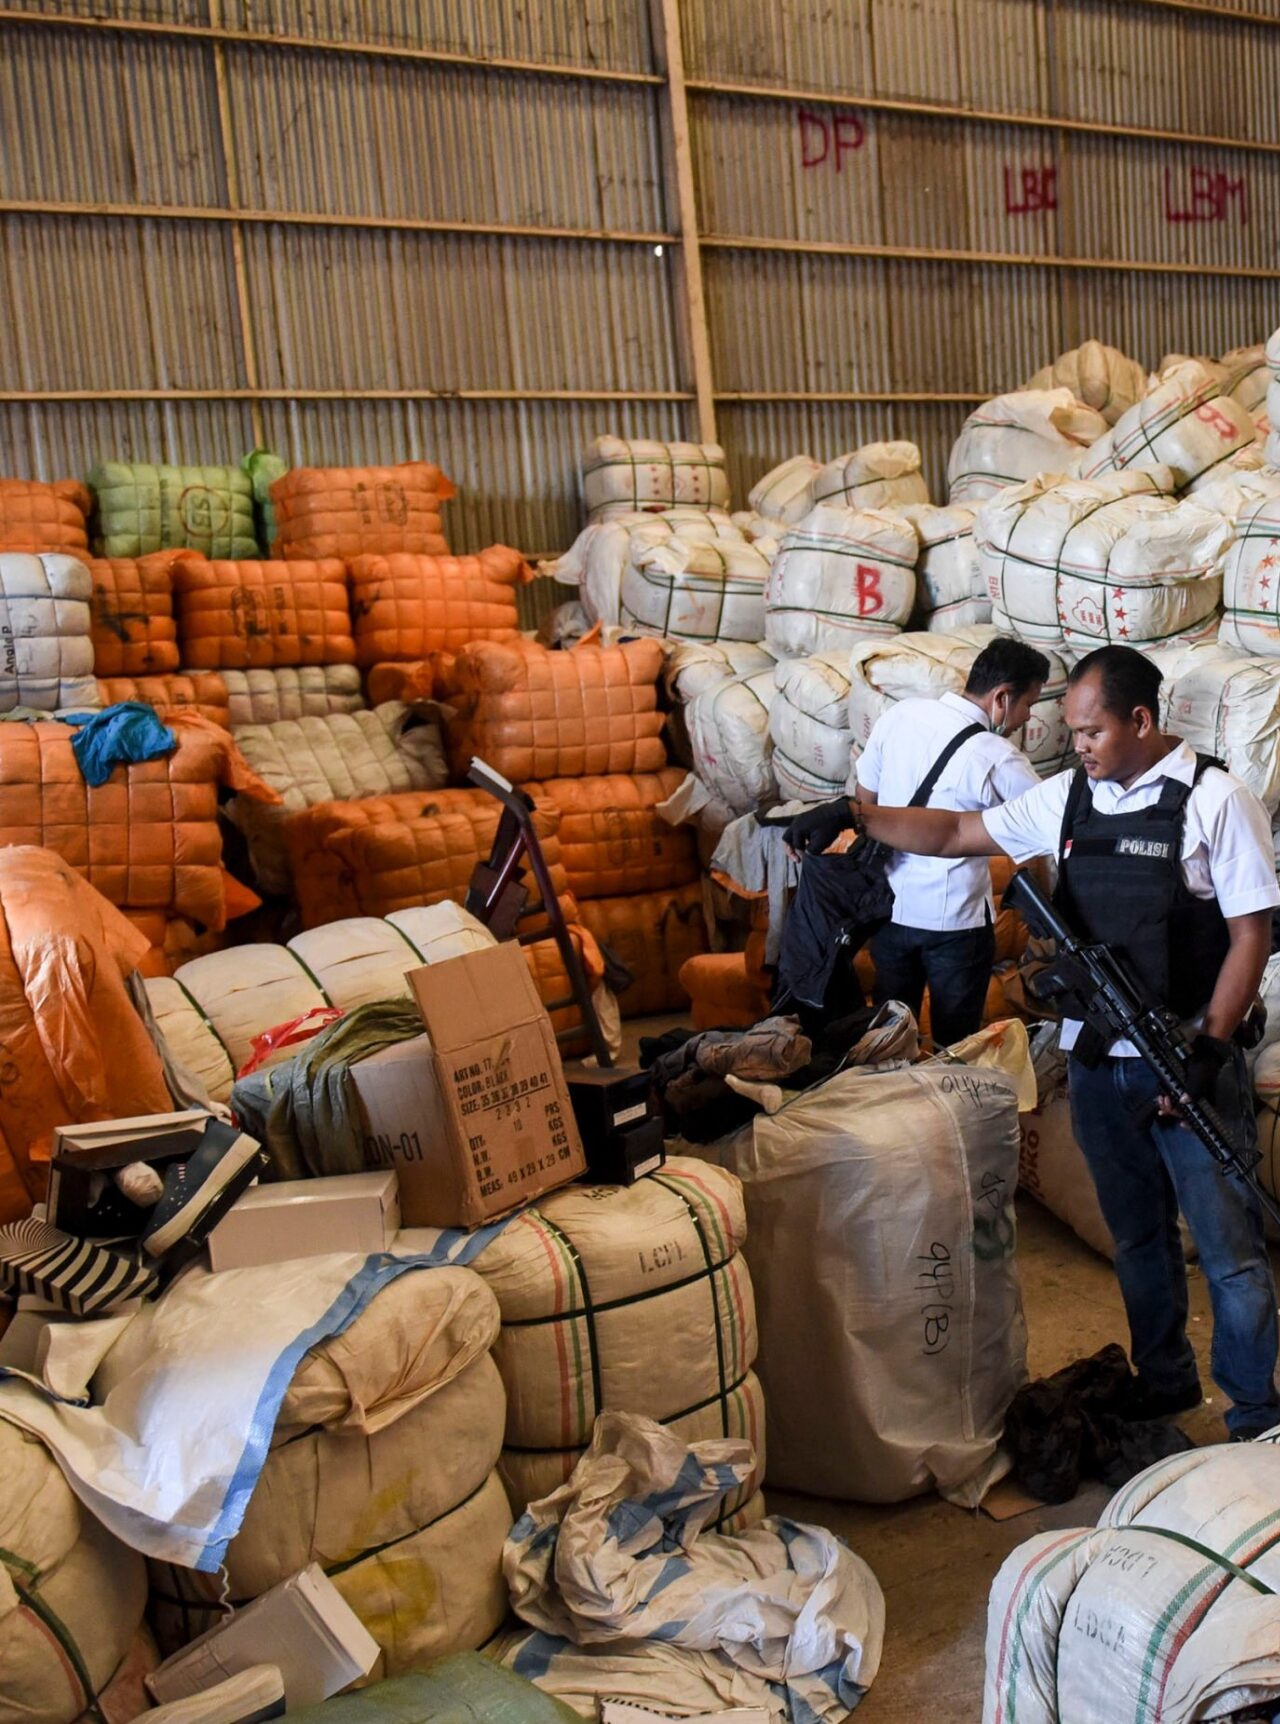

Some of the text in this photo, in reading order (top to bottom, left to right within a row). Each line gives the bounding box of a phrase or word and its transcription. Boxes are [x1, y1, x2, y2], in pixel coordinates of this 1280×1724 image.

[801, 112, 864, 173] DP
[856, 564, 884, 617] B
[1119, 838, 1170, 858] POLISI
